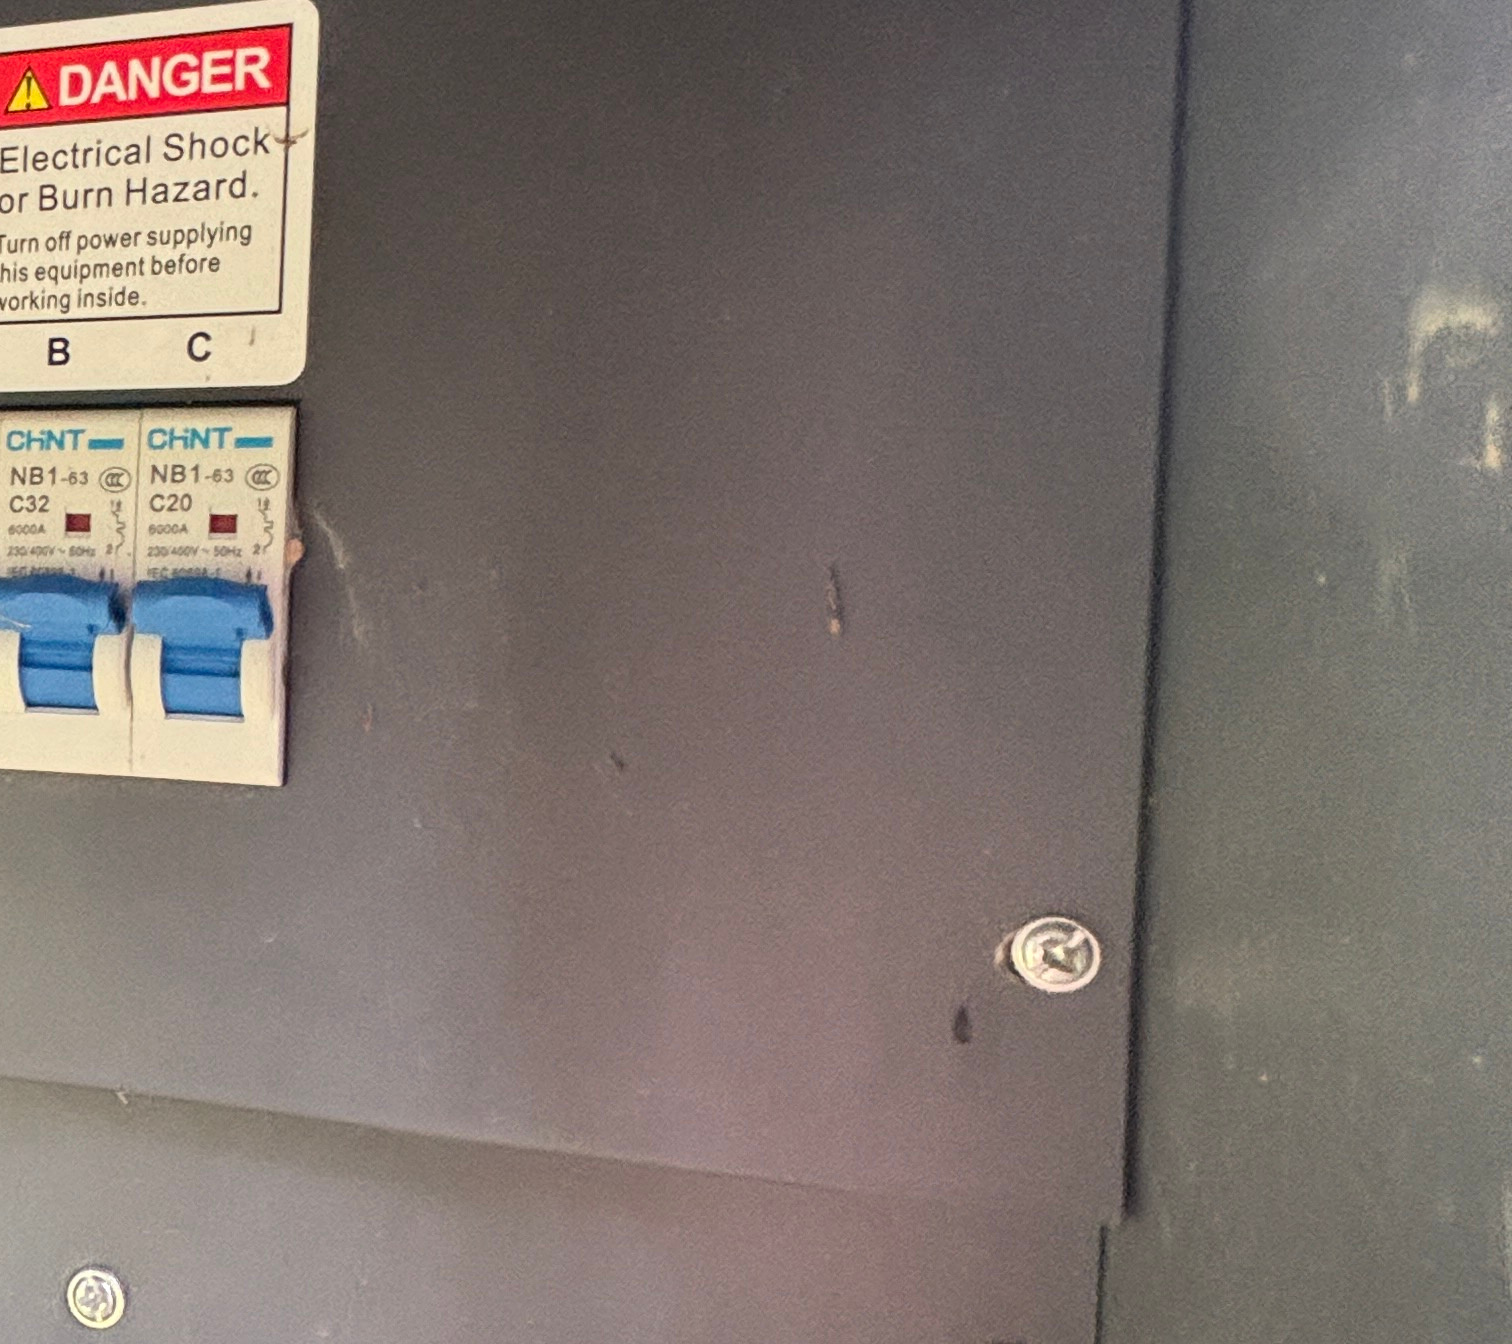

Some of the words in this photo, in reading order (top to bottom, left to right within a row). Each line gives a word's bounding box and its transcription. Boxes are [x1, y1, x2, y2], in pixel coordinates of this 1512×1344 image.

[58, 46, 272, 107] DANGER
[0, 134, 151, 175] Electrical
[162, 126, 271, 162] Shock
[38, 183, 113, 212] Burn
[125, 170, 260, 206] Hazard.
[44, 230, 73, 252] off
[76, 230, 142, 255] power
[146, 221, 253, 250] supplying
[34, 256, 145, 285] equipment
[150, 254, 221, 277] before
[76, 286, 148, 309] inside.
[47, 336, 71, 366] B
[186, 331, 212, 363] C
[9, 494, 50, 513] C32
[148, 493, 193, 513] C20
